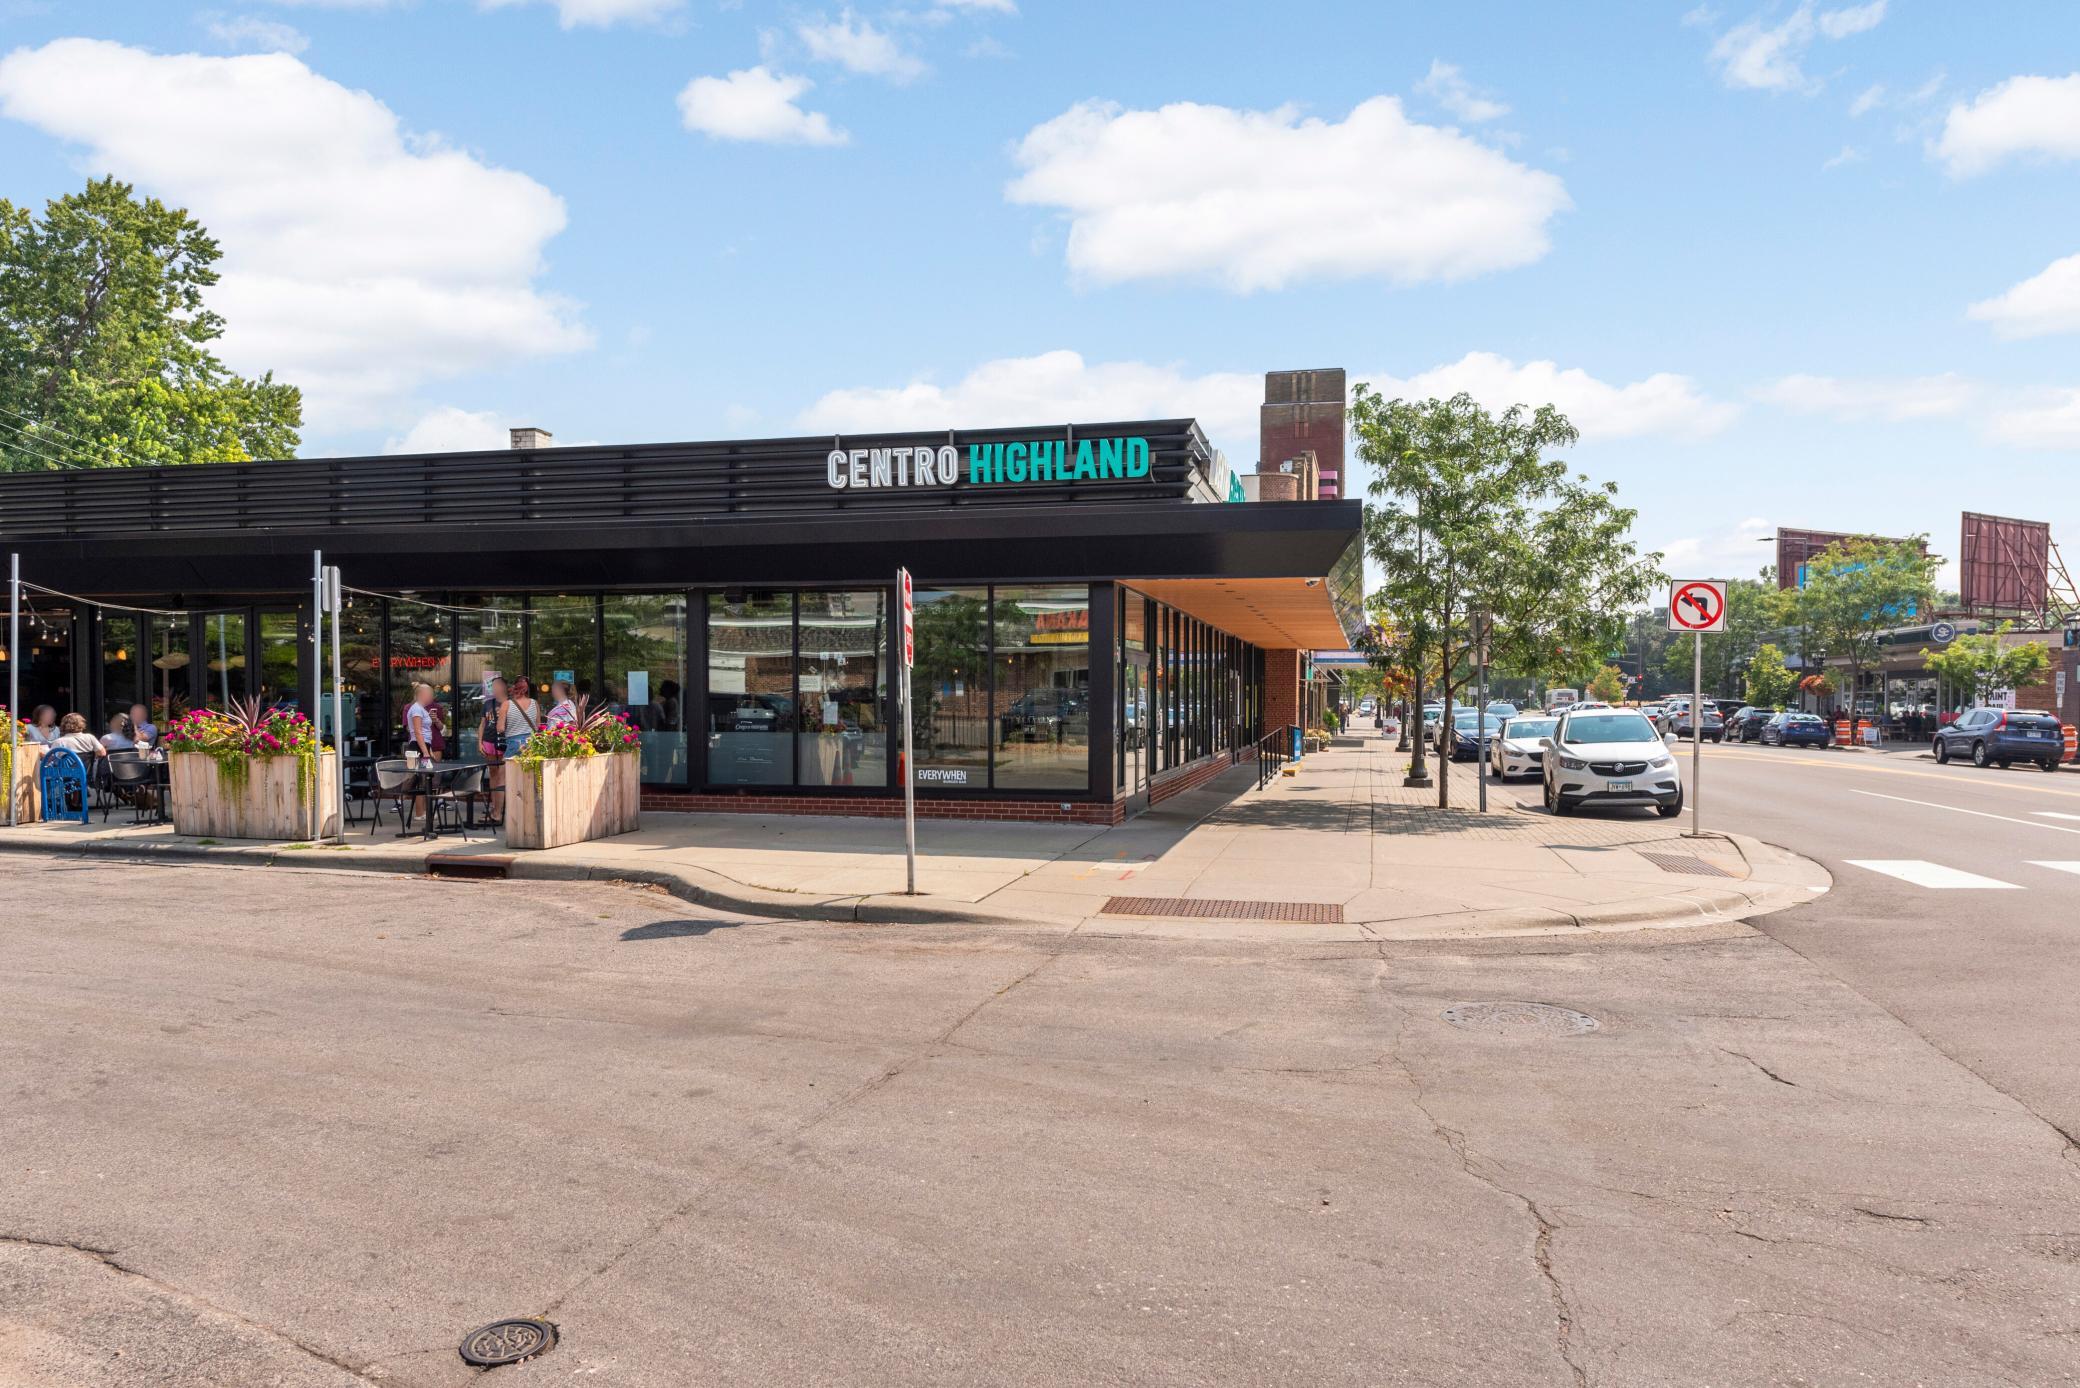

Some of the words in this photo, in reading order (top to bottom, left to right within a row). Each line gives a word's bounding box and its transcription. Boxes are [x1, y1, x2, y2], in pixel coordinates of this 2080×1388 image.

[827, 445, 959, 489] CENTRO
[968, 436, 1150, 484] HIGHLAND
[918, 769, 967, 780] EVERYWHEN
